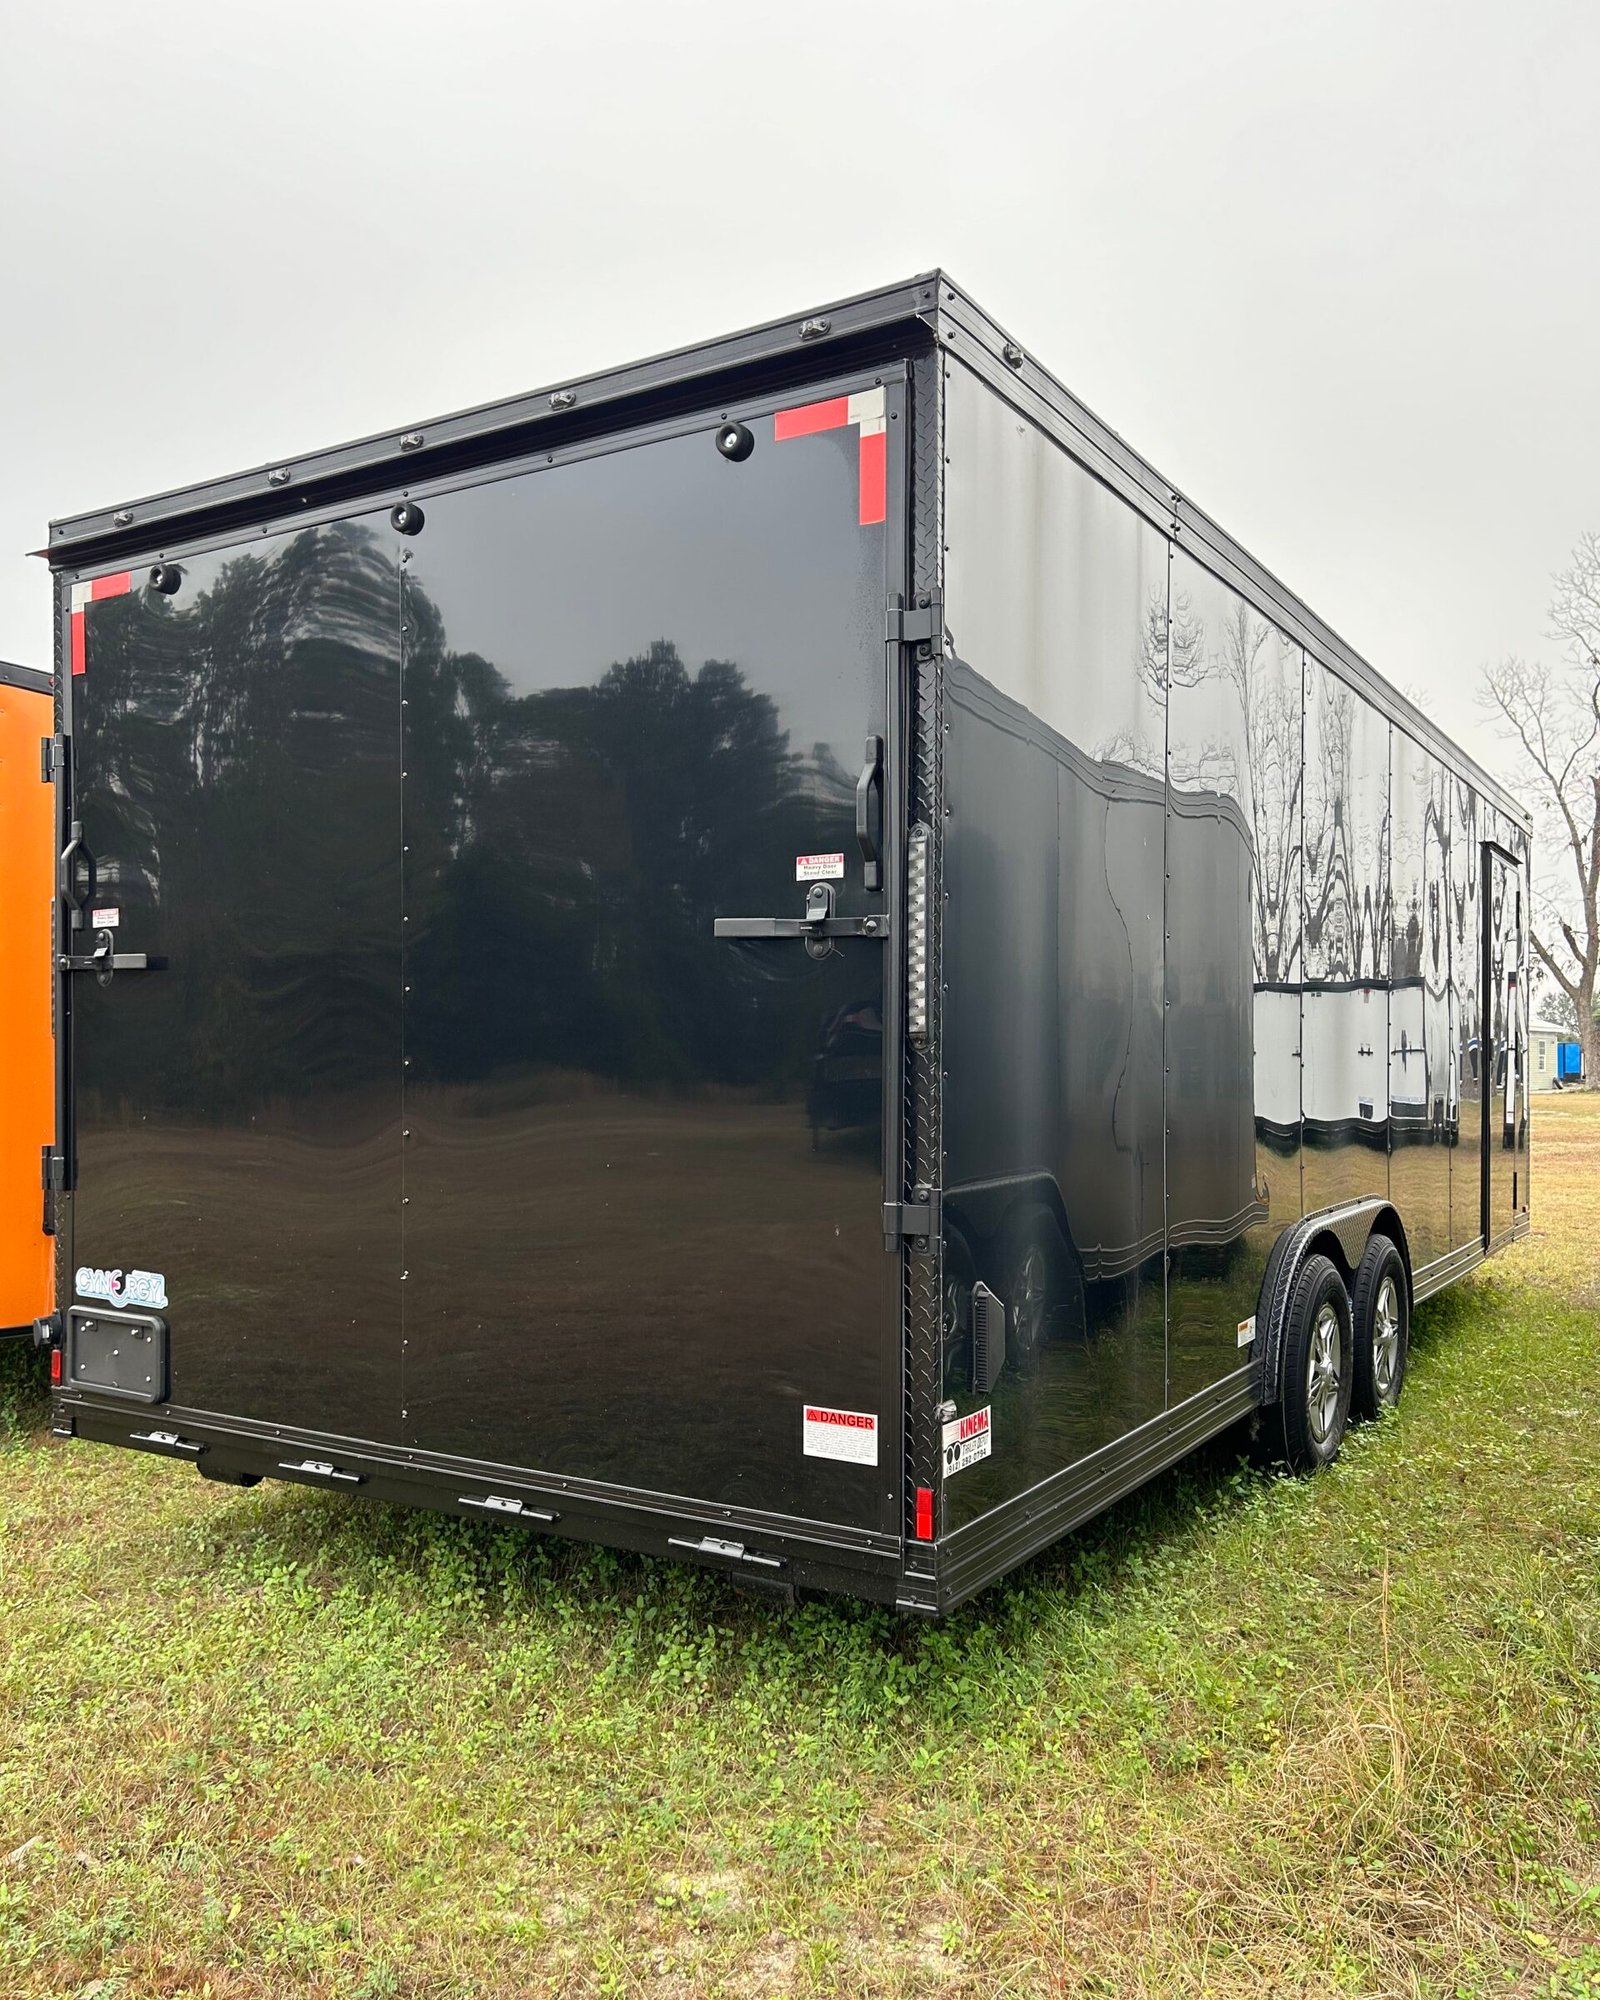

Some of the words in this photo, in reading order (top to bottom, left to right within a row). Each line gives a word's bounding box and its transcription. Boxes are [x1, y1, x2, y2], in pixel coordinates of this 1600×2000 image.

[808, 856, 840, 864] DANGER
[78, 1269, 162, 1302] CYNERGY
[820, 1411, 873, 1429] DANGER
[960, 1409, 989, 1440] KINEMA
